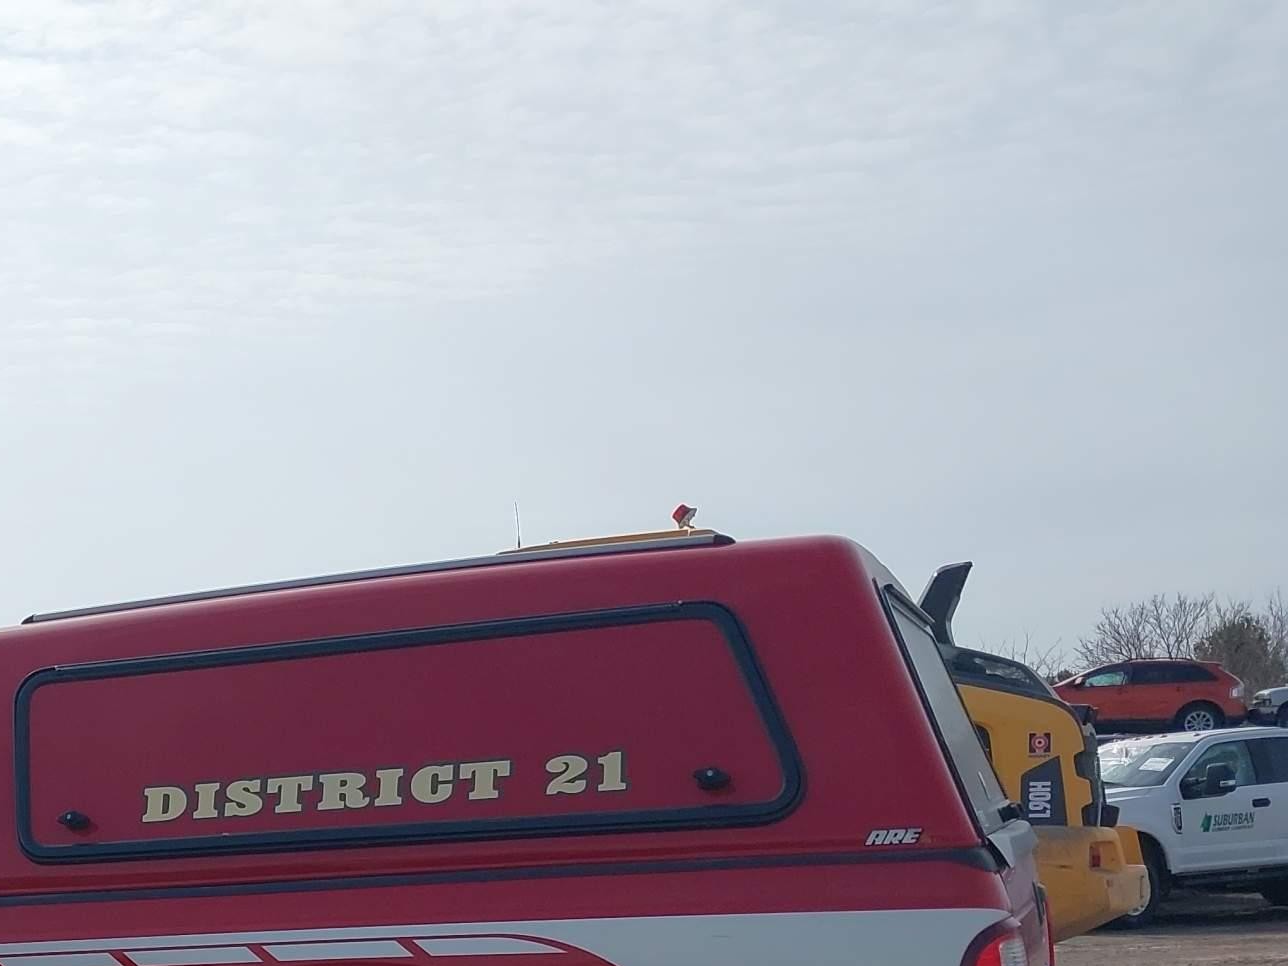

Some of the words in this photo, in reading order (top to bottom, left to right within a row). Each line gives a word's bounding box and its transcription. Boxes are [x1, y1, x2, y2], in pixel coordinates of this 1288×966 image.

[141, 760, 511, 823] DISTRICT
[544, 751, 627, 795] 21
[1028, 781, 1052, 818] L90H
[1212, 811, 1256, 827] SUBURBAN
[864, 827, 923, 846] ARE
